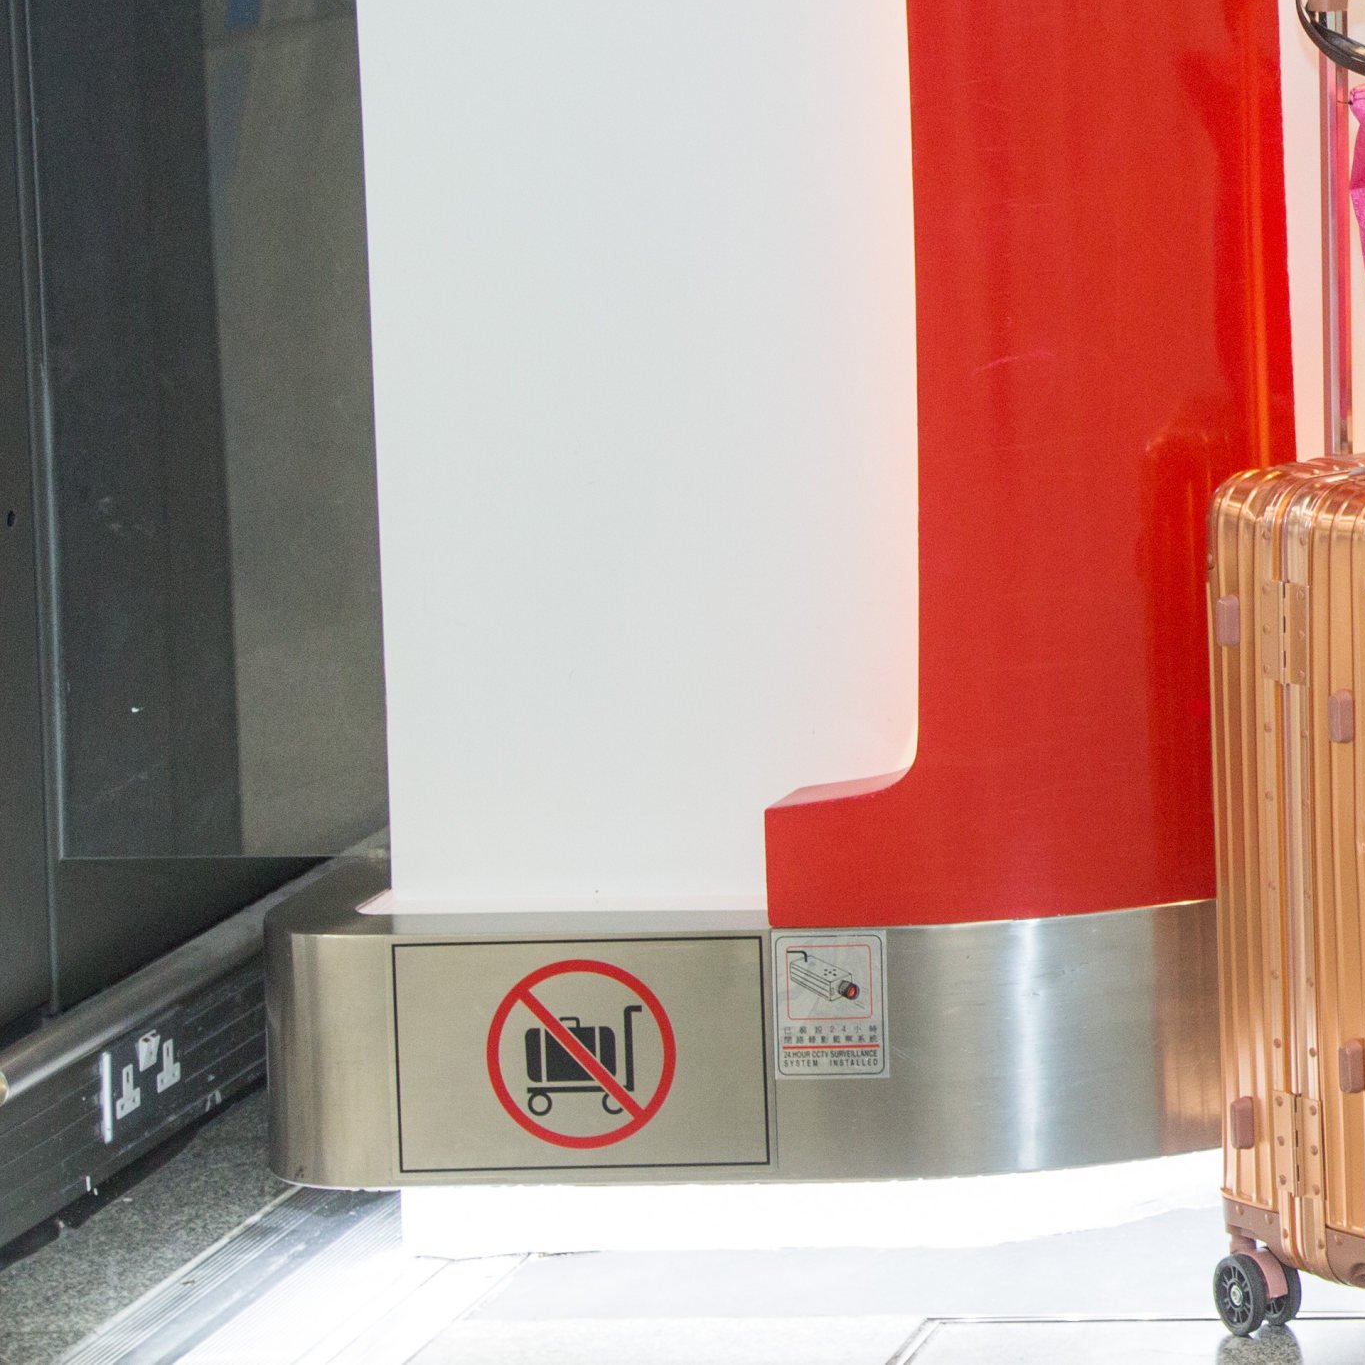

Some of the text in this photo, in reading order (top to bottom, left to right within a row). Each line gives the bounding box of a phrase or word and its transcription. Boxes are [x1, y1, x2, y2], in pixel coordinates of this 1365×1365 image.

[783, 1050, 878, 1059] 24 HOUR CCTV SURVEILLANCE
[783, 1058, 879, 1068] SYSTEM INSTALLED
